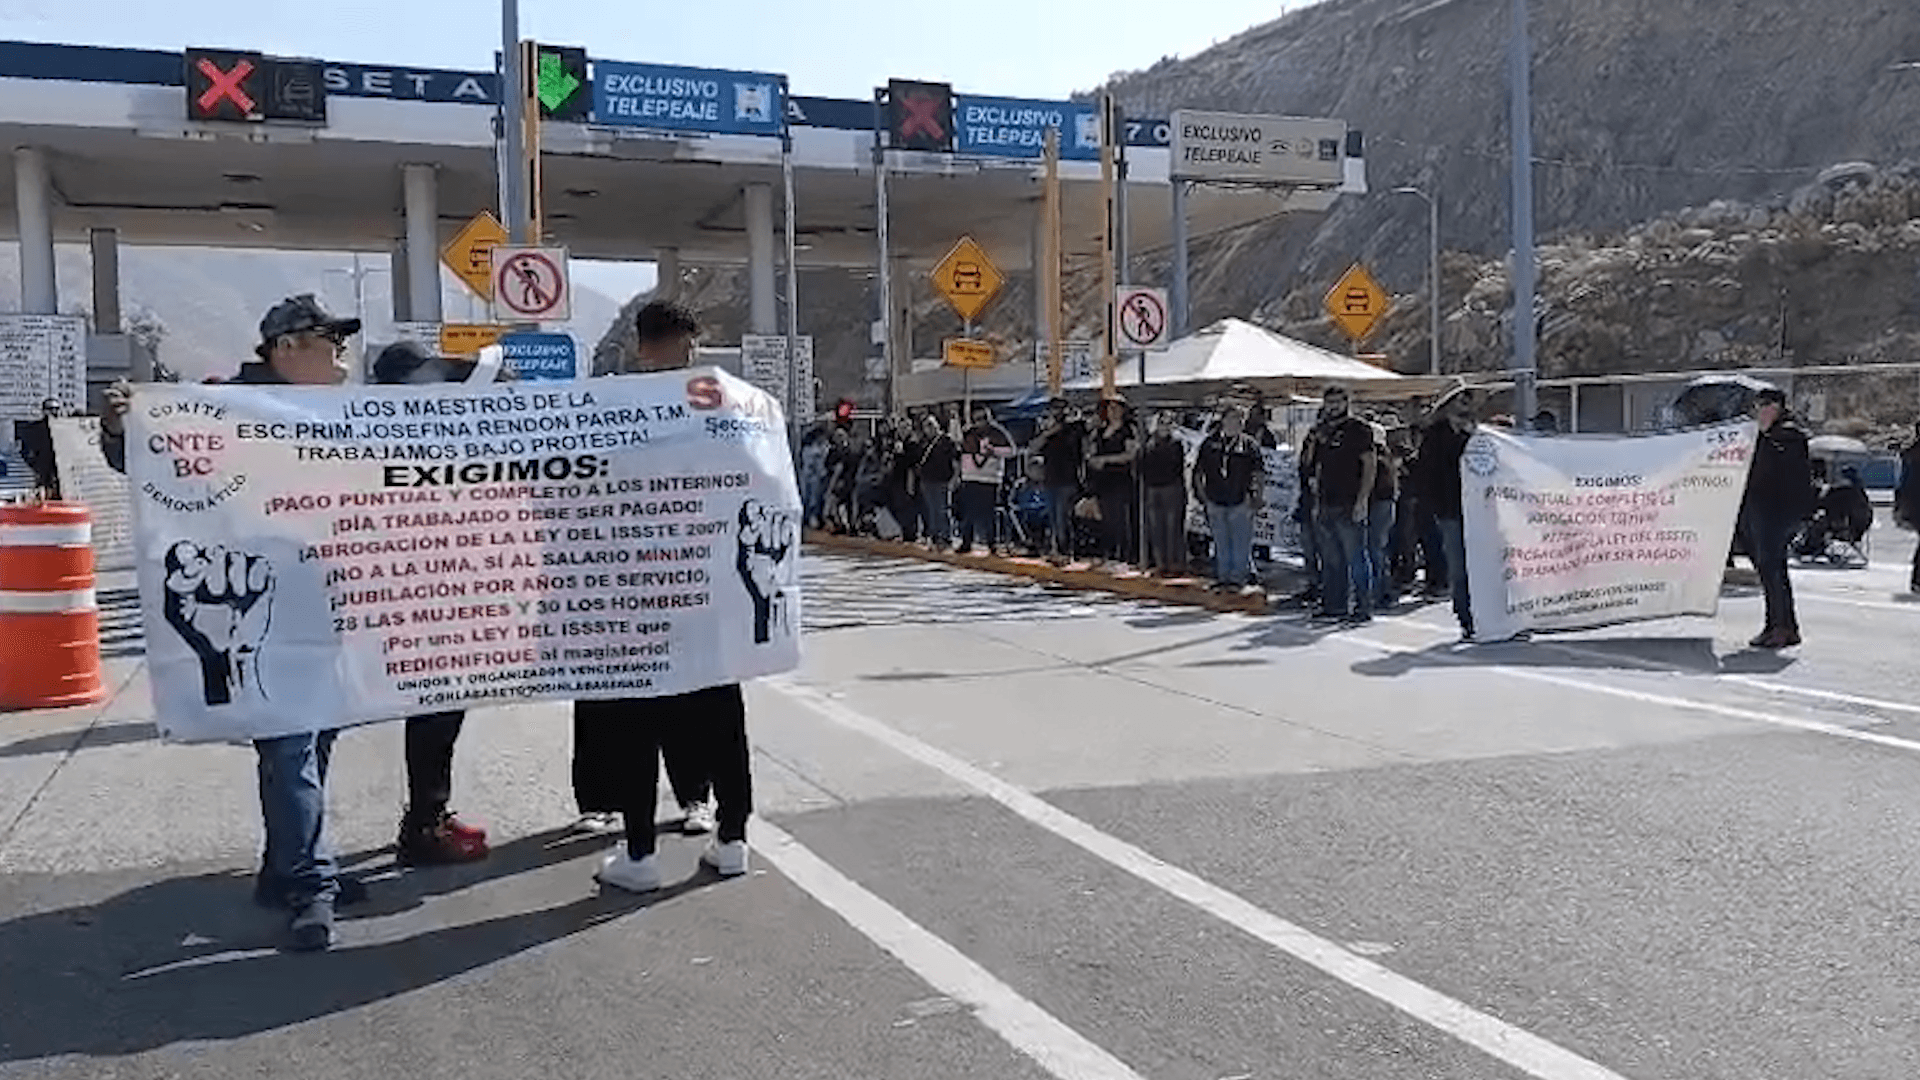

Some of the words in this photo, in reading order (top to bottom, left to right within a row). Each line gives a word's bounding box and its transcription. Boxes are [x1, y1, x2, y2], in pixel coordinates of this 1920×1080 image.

[604, 74, 719, 98] EXCLUSIVO
[606, 97, 719, 121] TELEPEAJE
[966, 105, 1063, 128] EXCLUSIVO
[966, 125, 1063, 147] TELEPEA
[1184, 125, 1262, 142] EXCLUSIVO
[1185, 146, 1262, 164] TELEPEAJE
[149, 401, 228, 421] COMITÉ
[344, 400, 396, 419] ¡LOS
[404, 396, 527, 416] MAESTROS
[534, 394, 562, 409] DE
[568, 392, 597, 407] LA
[477, 415, 569, 436] RENDON
[577, 408, 648, 430] PARRA
[651, 404, 691, 422] T.M.
[147, 433, 224, 454] CNTE
[295, 444, 459, 461] TRABAJAMOS
[465, 440, 524, 458] BAJO
[533, 429, 649, 452] PROTESTA!
[173, 457, 214, 478] BC
[383, 454, 609, 488] EXIGIMOS:
[142, 474, 247, 512] DEMOCRÁTICO
[264, 494, 332, 515] ¡PAGO
[339, 490, 442, 507] PUNTUAL
[450, 489, 461, 502] Y
[469, 485, 580, 501] COMPLETO
[587, 484, 600, 496] A
[606, 479, 643, 494] LOS
[650, 472, 749, 492] INTERINOS!
[382, 509, 510, 529] TRABAJADO
[518, 506, 570, 521] DEBE
[576, 503, 614, 520] SER
[620, 500, 704, 517] PAGADO!
[456, 533, 483, 548] DE
[490, 531, 515, 545] LA
[522, 526, 561, 543] LEY
[567, 525, 607, 541] DEL
[611, 523, 682, 540] ISSSTE
[326, 566, 364, 587] ¡NO
[370, 564, 385, 578] A
[391, 562, 418, 576] LA
[511, 553, 536, 568] AL
[543, 549, 629, 566] SALARIO
[474, 578, 515, 594] POR
[522, 574, 578, 591] AÑOS
[584, 574, 610, 588] DE
[333, 616, 358, 633] 28
[365, 611, 405, 628] LAS
[412, 603, 511, 622] MUJERES
[517, 602, 531, 616] Y
[536, 599, 560, 615] 30
[566, 598, 605, 612] LOS
[611, 592, 709, 610] HOMBRES!
[429, 633, 465, 647] una
[472, 626, 510, 642] LEY
[518, 623, 556, 639] DEL
[562, 619, 631, 637] ISSSTE
[636, 621, 671, 637] que
[386, 648, 537, 676] REDIGNIFIQUE
[540, 647, 558, 661] al
[563, 640, 670, 661] magisterio!
[397, 676, 451, 692] UNIDOS
[456, 674, 464, 686] Y
